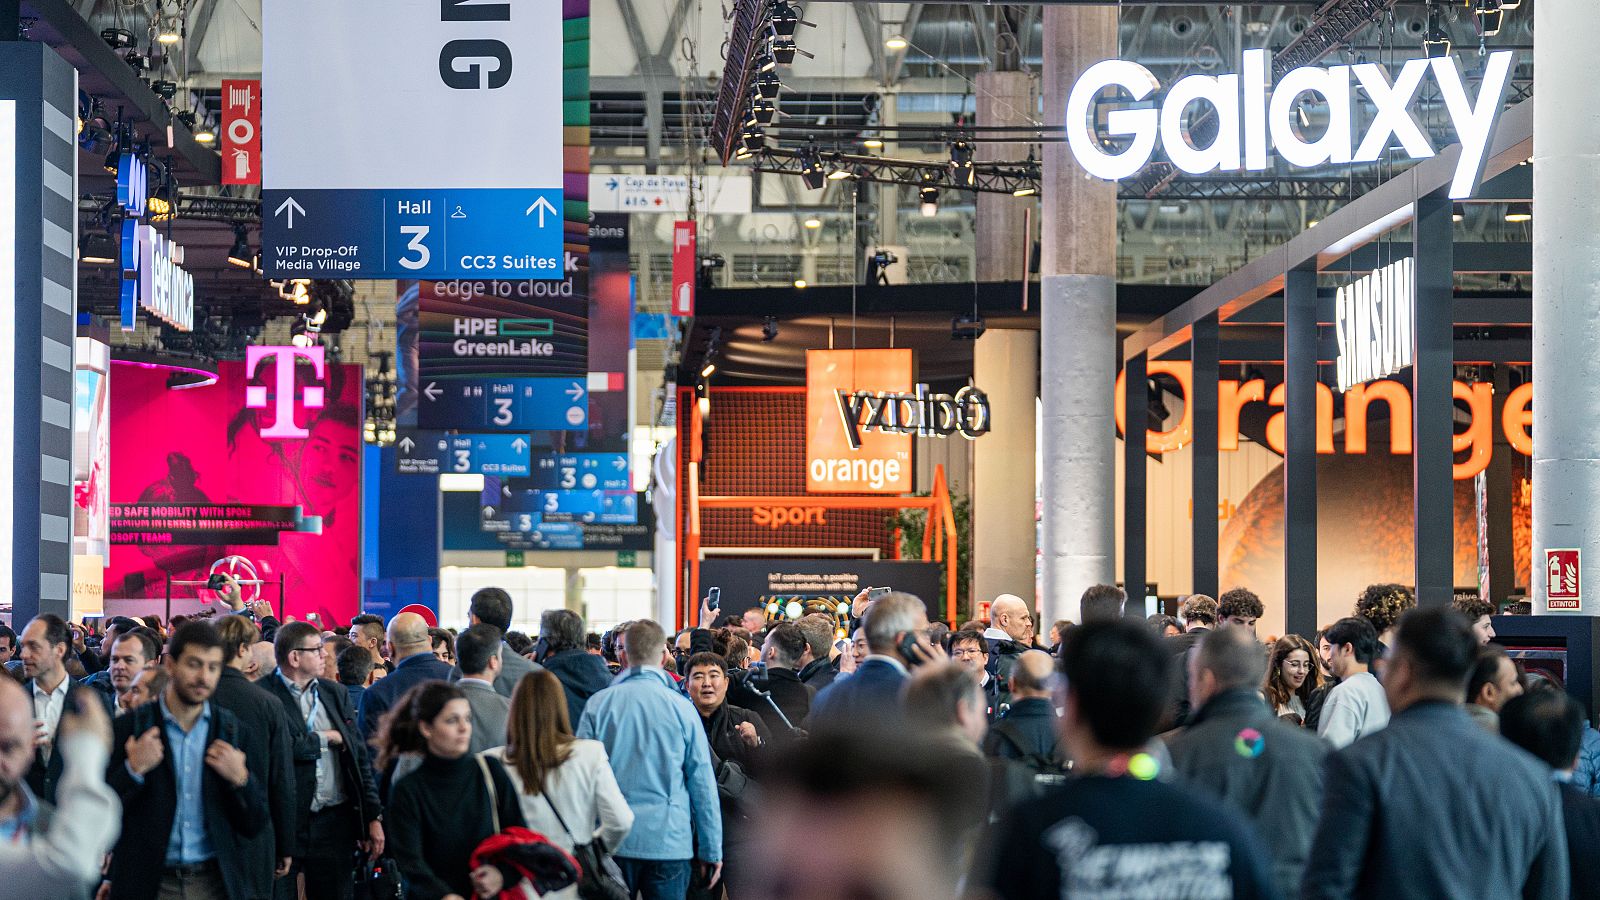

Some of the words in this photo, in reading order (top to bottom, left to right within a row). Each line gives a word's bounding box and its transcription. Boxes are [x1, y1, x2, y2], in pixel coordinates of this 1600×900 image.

[1066, 48, 1514, 199] Galaxy
[398, 200, 431, 214] Hall
[276, 246, 297, 257] VIP
[301, 246, 358, 258] Drop-Off
[398, 225, 431, 270] 3
[276, 259, 313, 270] Media
[317, 260, 361, 271] Village
[460, 255, 496, 269] CC3
[502, 254, 557, 269] Suites
[434, 279, 486, 301] edge
[491, 279, 512, 298] to
[517, 277, 573, 298] cloud
[453, 318, 498, 337] HPE
[1336, 256, 1414, 394] SAMSUN
[453, 338, 554, 357] GreenLake
[246, 345, 324, 439] T
[493, 384, 514, 394] Hall
[493, 398, 513, 426] 3
[454, 449, 471, 473] 3
[560, 467, 577, 489] 3
[810, 458, 901, 489] orange
[124, 506, 149, 518] SAFE
[151, 506, 197, 518] MOBILITY
[200, 506, 224, 518] WITH
[544, 492, 559, 513] 3
[519, 514, 532, 532] 3
[752, 505, 827, 529] Sport
[141, 532, 173, 543] TEAMS
[1550, 600, 1577, 608] EXTINTOR
